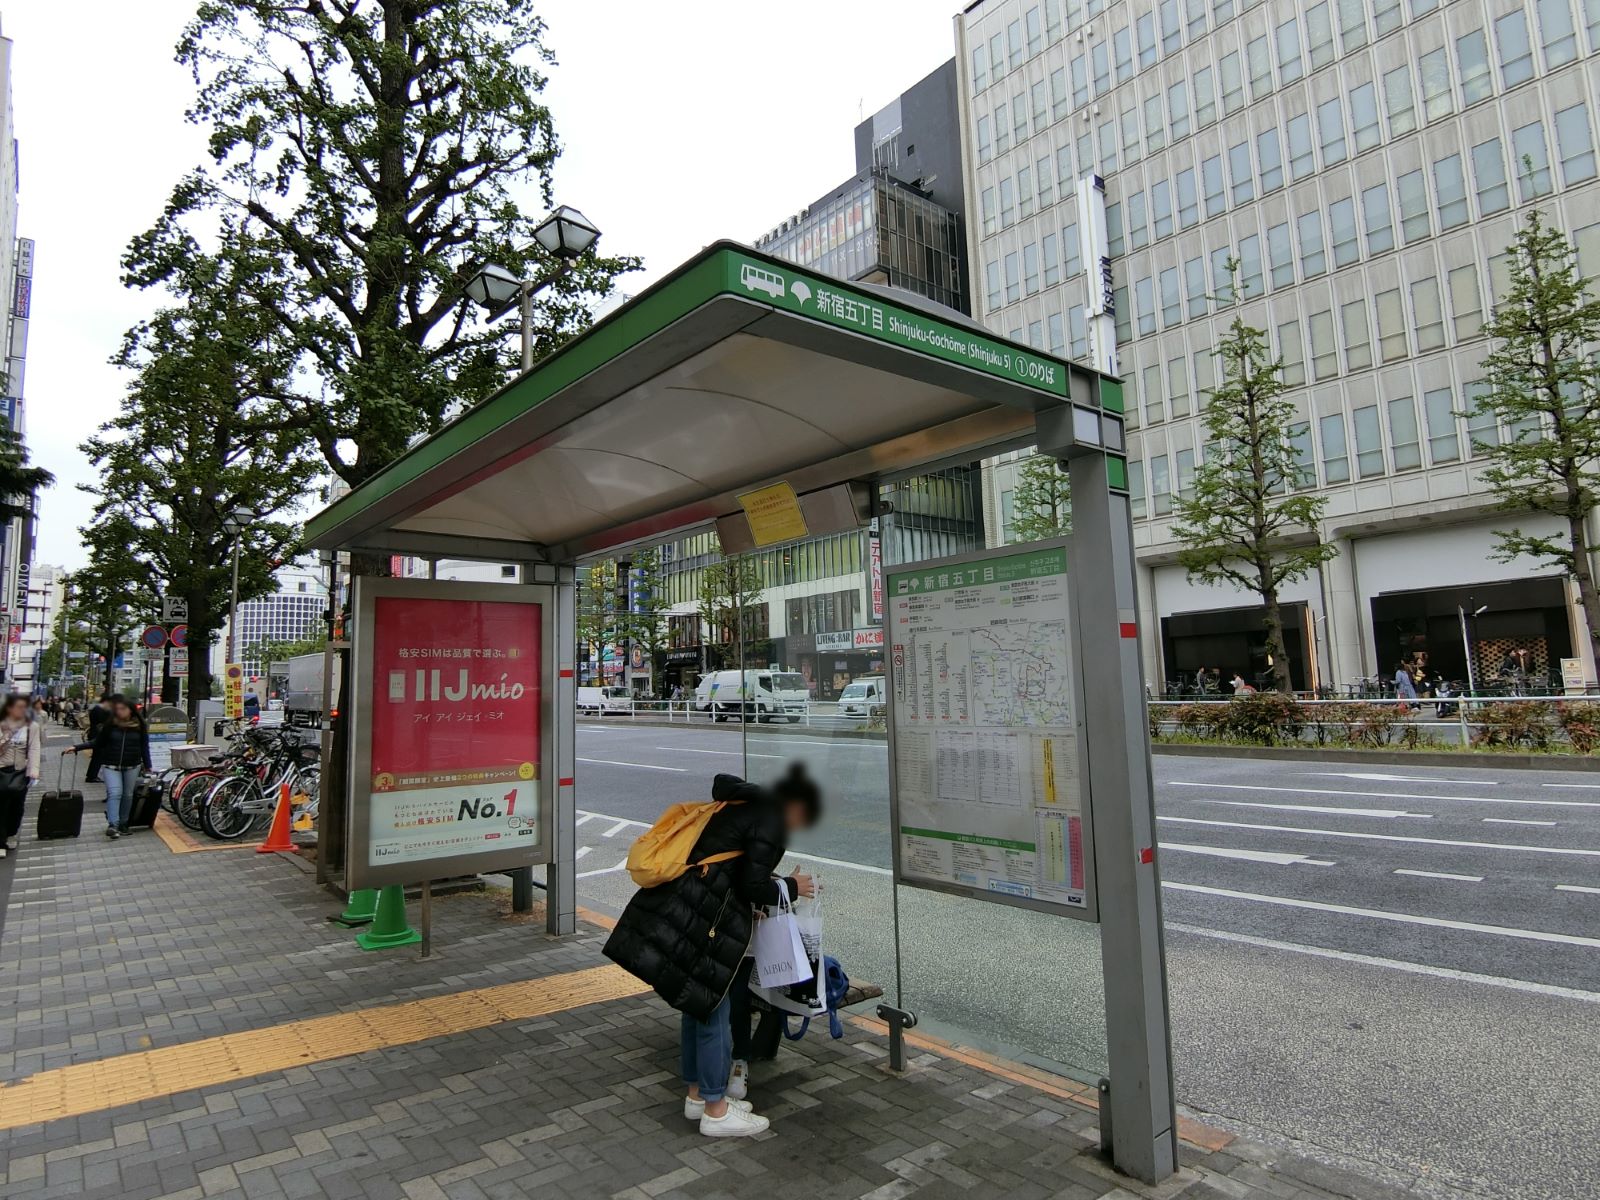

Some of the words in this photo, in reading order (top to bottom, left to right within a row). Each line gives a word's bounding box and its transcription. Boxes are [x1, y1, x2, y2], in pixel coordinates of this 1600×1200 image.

[1099, 255, 1115, 317] ISETAN
[816, 288, 884, 332] 新宿五丁目
[889, 317, 967, 355] Shinjuku-Gochōme
[967, 341, 1004, 367] (Shinjuku
[1003, 355, 1013, 371] 5)
[924, 566, 994, 590] 新宿五丁目
[457, 788, 519, 822] No.1
[763, 961, 792, 975] ALBION
